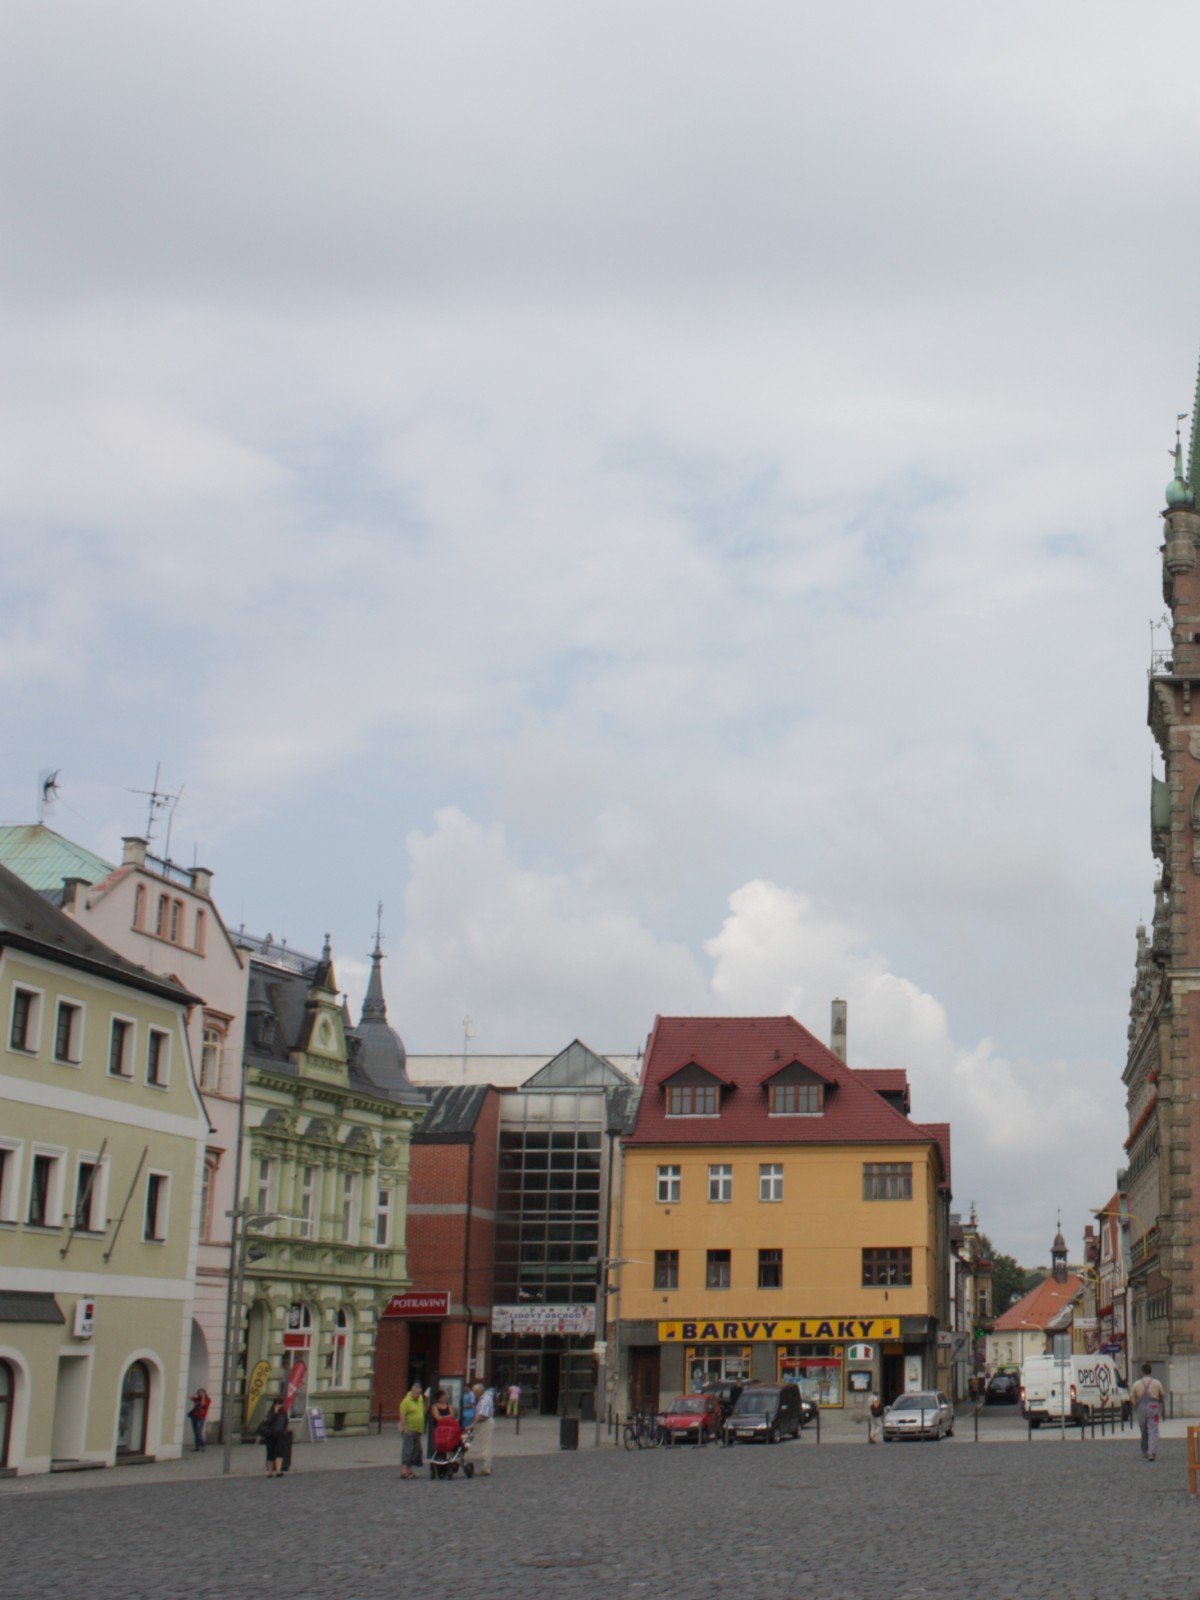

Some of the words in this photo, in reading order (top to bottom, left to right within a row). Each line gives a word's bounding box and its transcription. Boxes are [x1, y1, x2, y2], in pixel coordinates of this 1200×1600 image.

[393, 1298, 447, 1309] POTRAVINY
[681, 1321, 778, 1340] BARVY
[799, 1319, 875, 1339] LAKY
[1078, 1368, 1095, 1384] DPD
